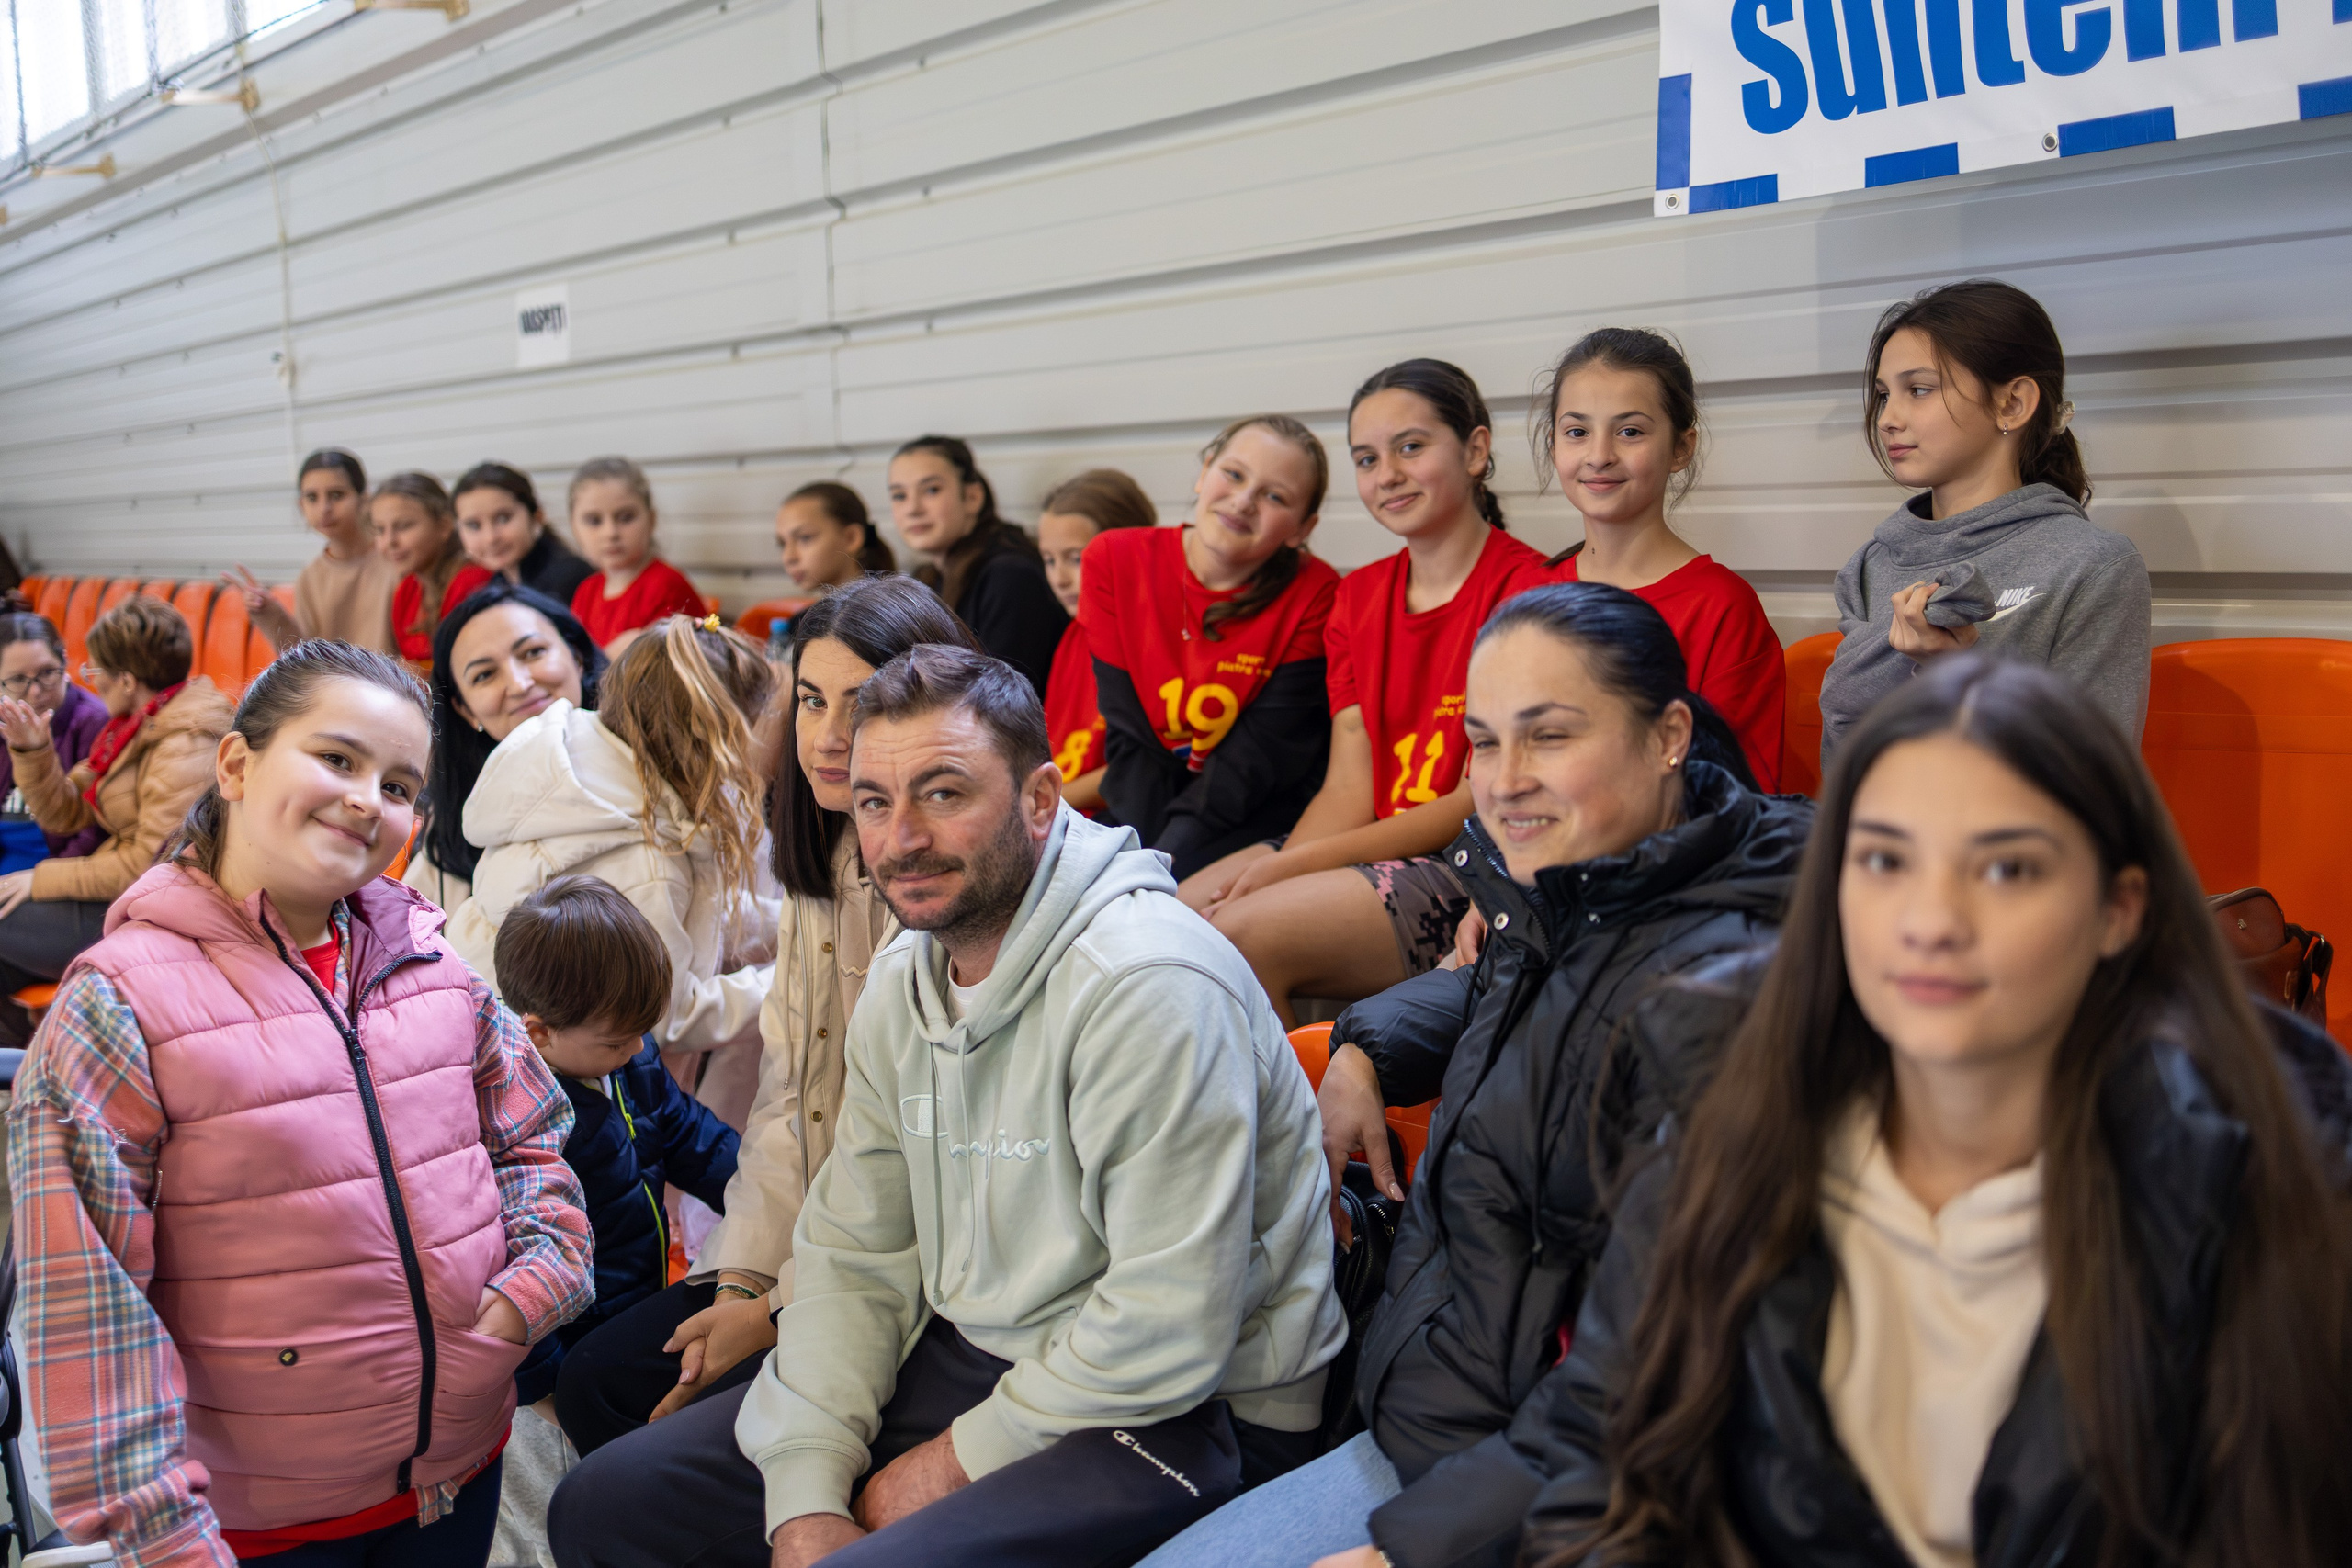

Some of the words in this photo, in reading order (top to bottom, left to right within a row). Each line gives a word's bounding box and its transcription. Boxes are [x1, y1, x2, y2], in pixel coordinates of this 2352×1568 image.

[1995, 585, 2036, 607] NIKE
[1158, 676, 1239, 751] 19
[1390, 729, 1444, 804] 11
[1113, 1429, 1200, 1497] Champion
